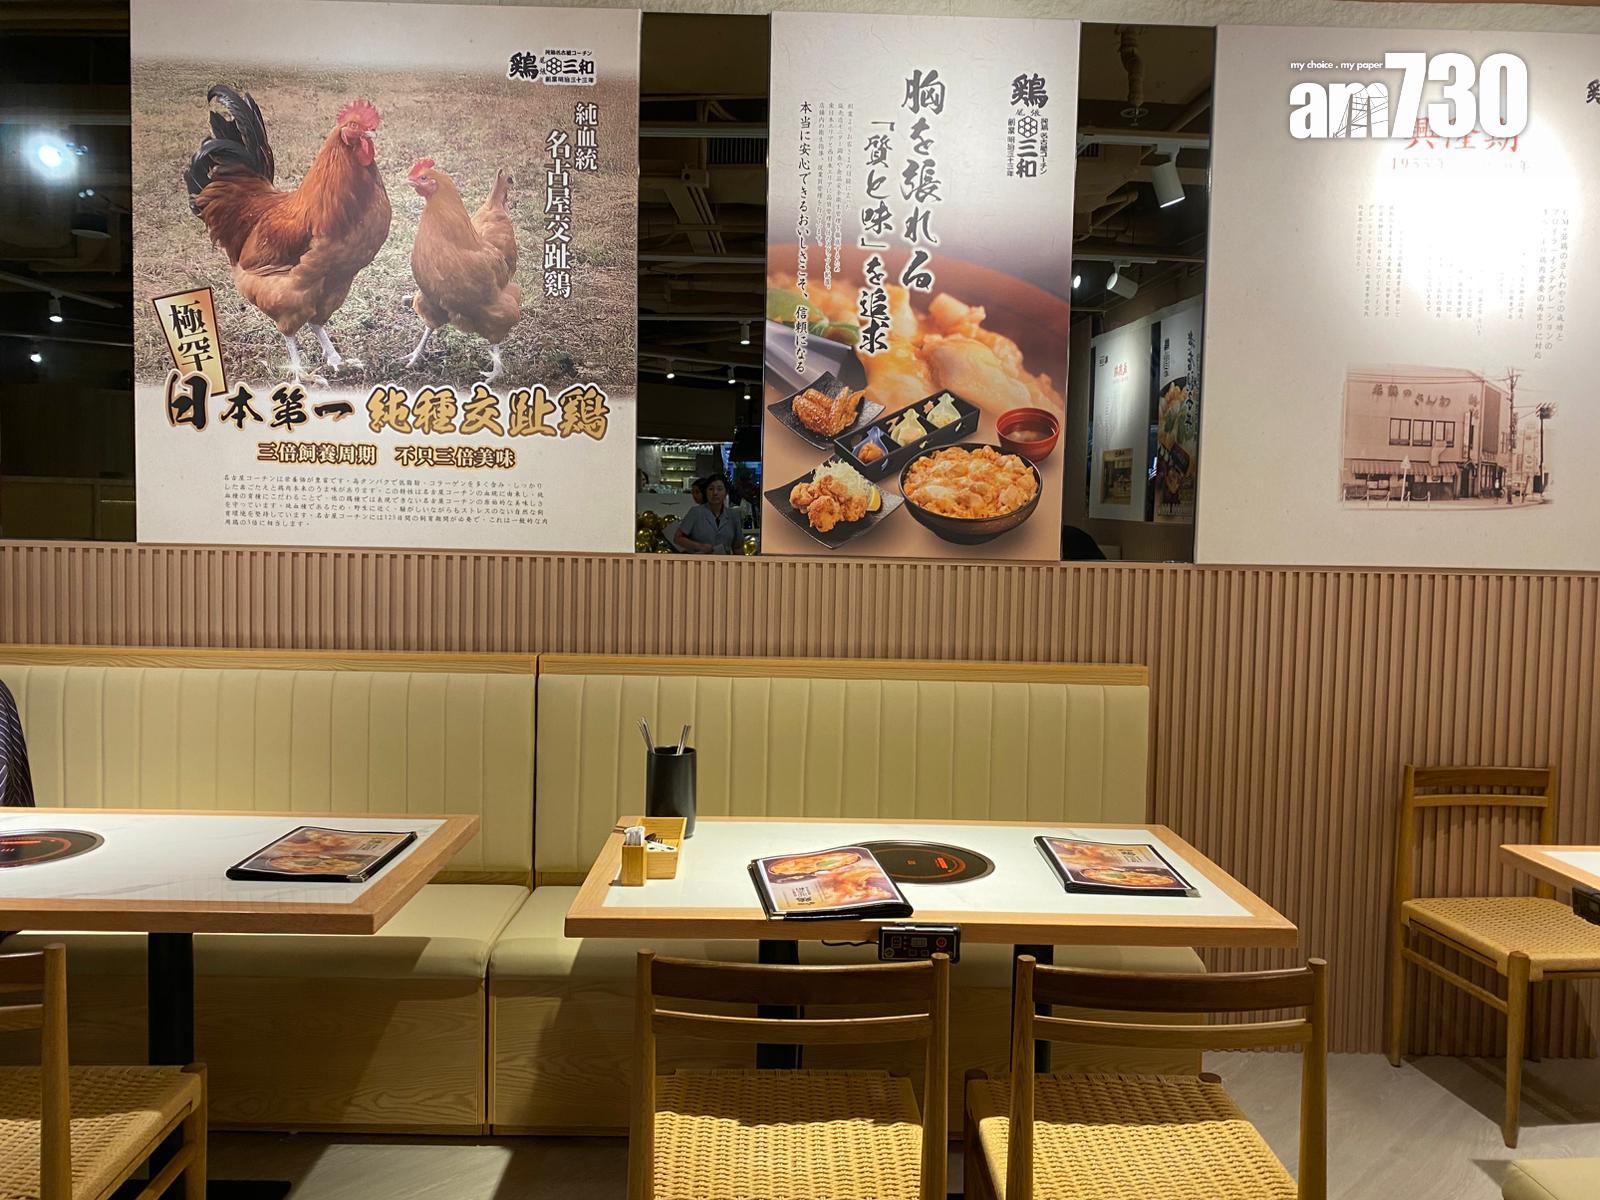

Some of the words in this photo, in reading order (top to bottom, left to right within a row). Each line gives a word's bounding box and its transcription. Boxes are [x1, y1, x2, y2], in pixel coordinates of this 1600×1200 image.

[563, 59, 594, 75] 三和
[575, 103, 598, 170] 純血統
[1016, 139, 1038, 178] 三和
[901, 69, 945, 290] 胸を張れる
[859, 121, 895, 353] 「質と味」を追求
[169, 374, 353, 430] 日本第一
[258, 442, 378, 464] 三倍飼養周期
[395, 446, 515, 467] 不只三倍美味
